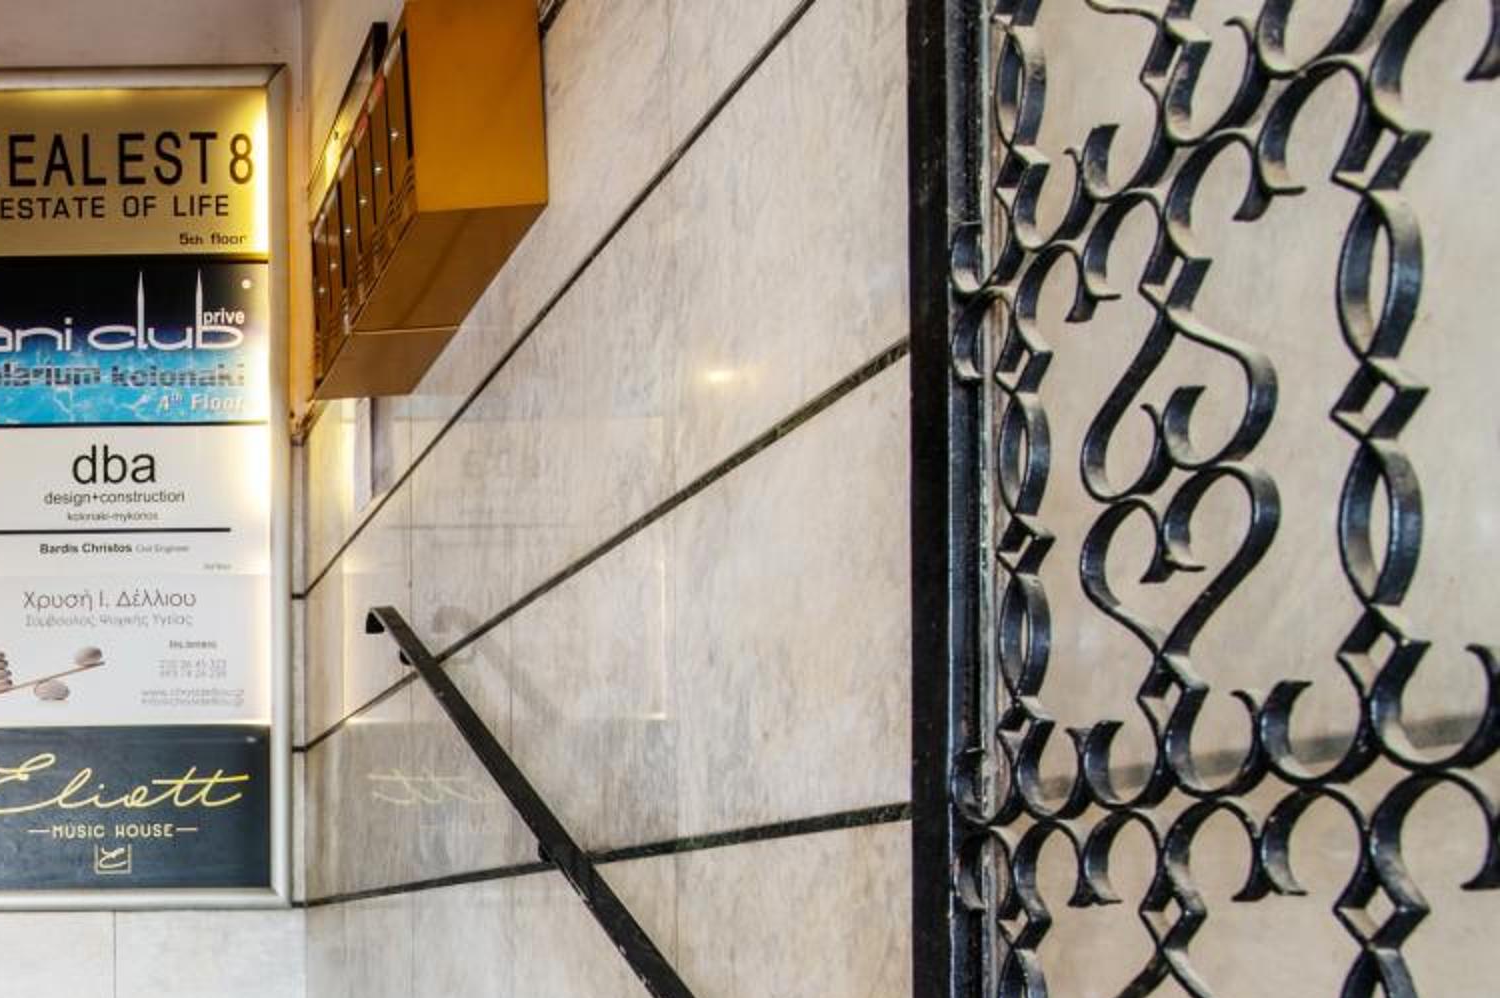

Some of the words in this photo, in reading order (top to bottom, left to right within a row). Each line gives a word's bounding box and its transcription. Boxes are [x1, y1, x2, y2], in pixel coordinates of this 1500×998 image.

[0, 196, 105, 220] ESTATE
[122, 195, 157, 218] OF
[173, 194, 230, 217] LIFE
[179, 232, 202, 246] 5th
[210, 232, 247, 245] floor
[86, 267, 245, 351] club
[202, 306, 246, 326] prive
[111, 362, 245, 387] kolonaki
[72, 444, 157, 485] dba
[43, 490, 186, 506] design+construction
[39, 543, 79, 554] Bardis
[82, 542, 133, 554] Christos
[22, 590, 93, 612] Χρυσή
[115, 588, 197, 608] Δέλλιου
[52, 824, 105, 840] MUSIC
[115, 823, 175, 838] HOUSE
